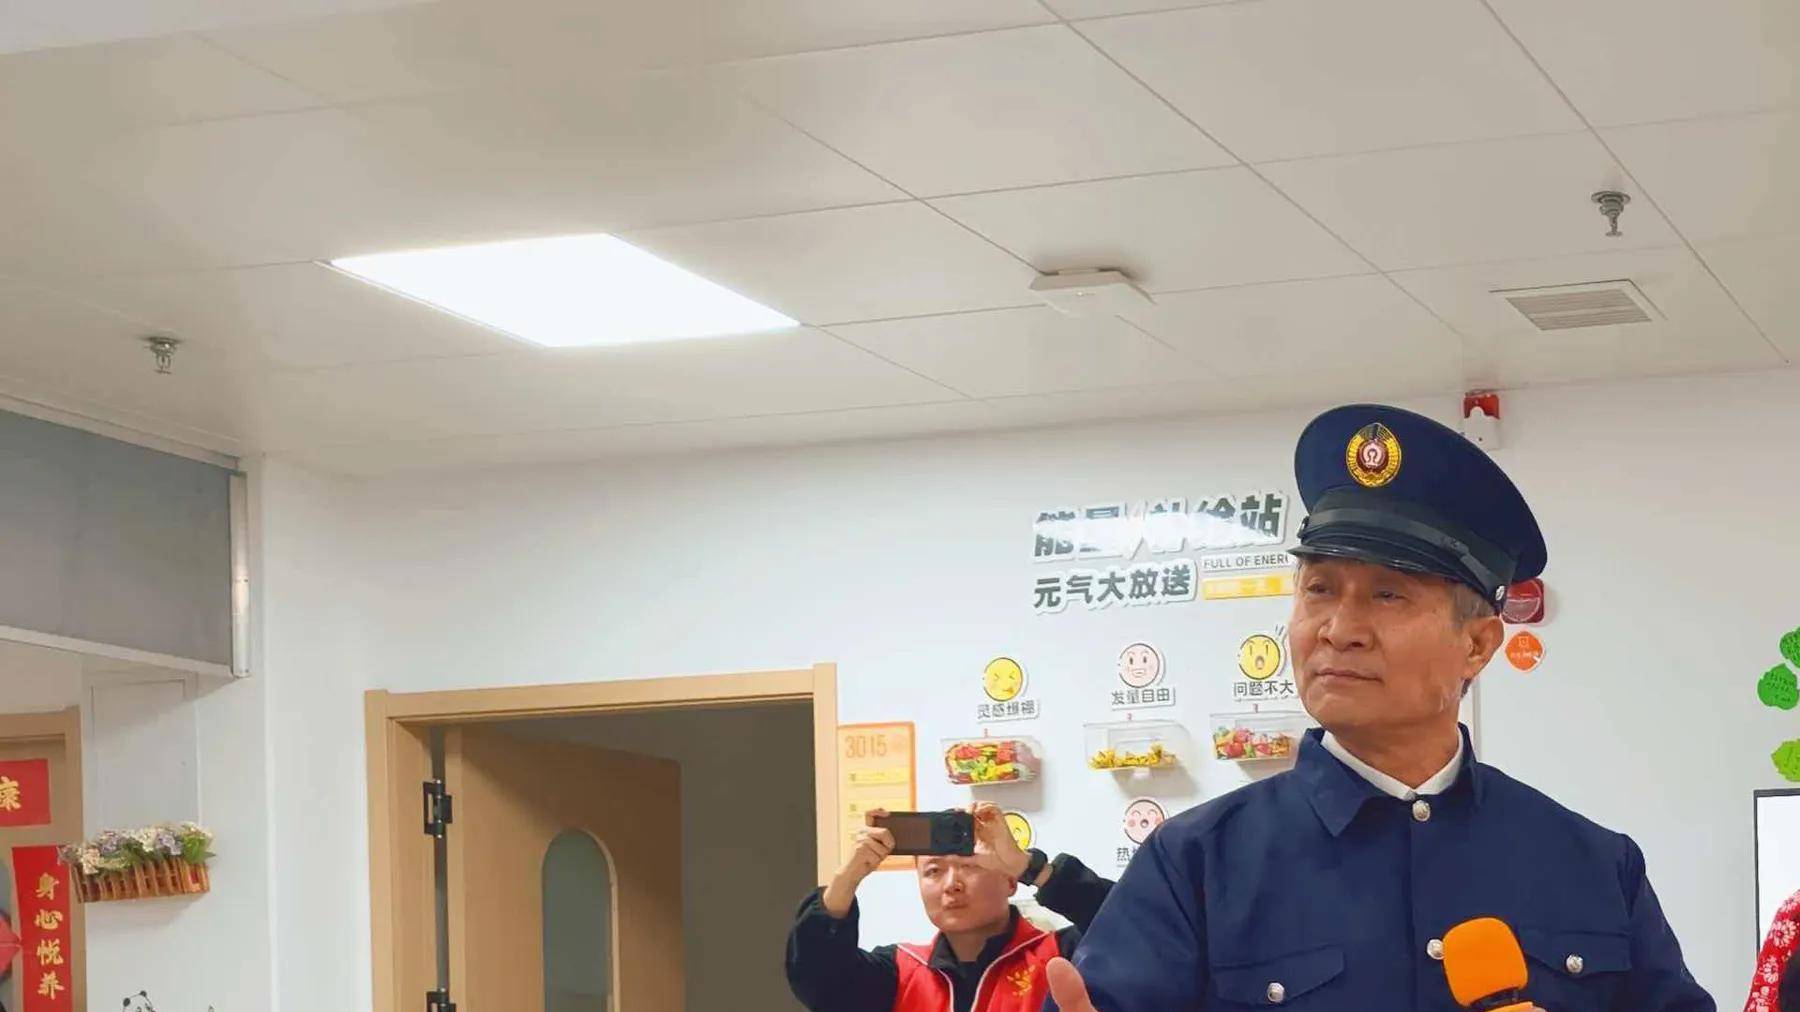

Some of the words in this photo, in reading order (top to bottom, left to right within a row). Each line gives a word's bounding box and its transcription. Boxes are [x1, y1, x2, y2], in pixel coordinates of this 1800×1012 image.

[1203, 558, 1232, 569] FULL
[1235, 556, 1252, 566] OF
[1034, 565, 1191, 608] 元气大放送
[1110, 687, 1171, 706] 发量自由
[1232, 679, 1294, 697] 问题不大
[845, 735, 888, 759] 3015
